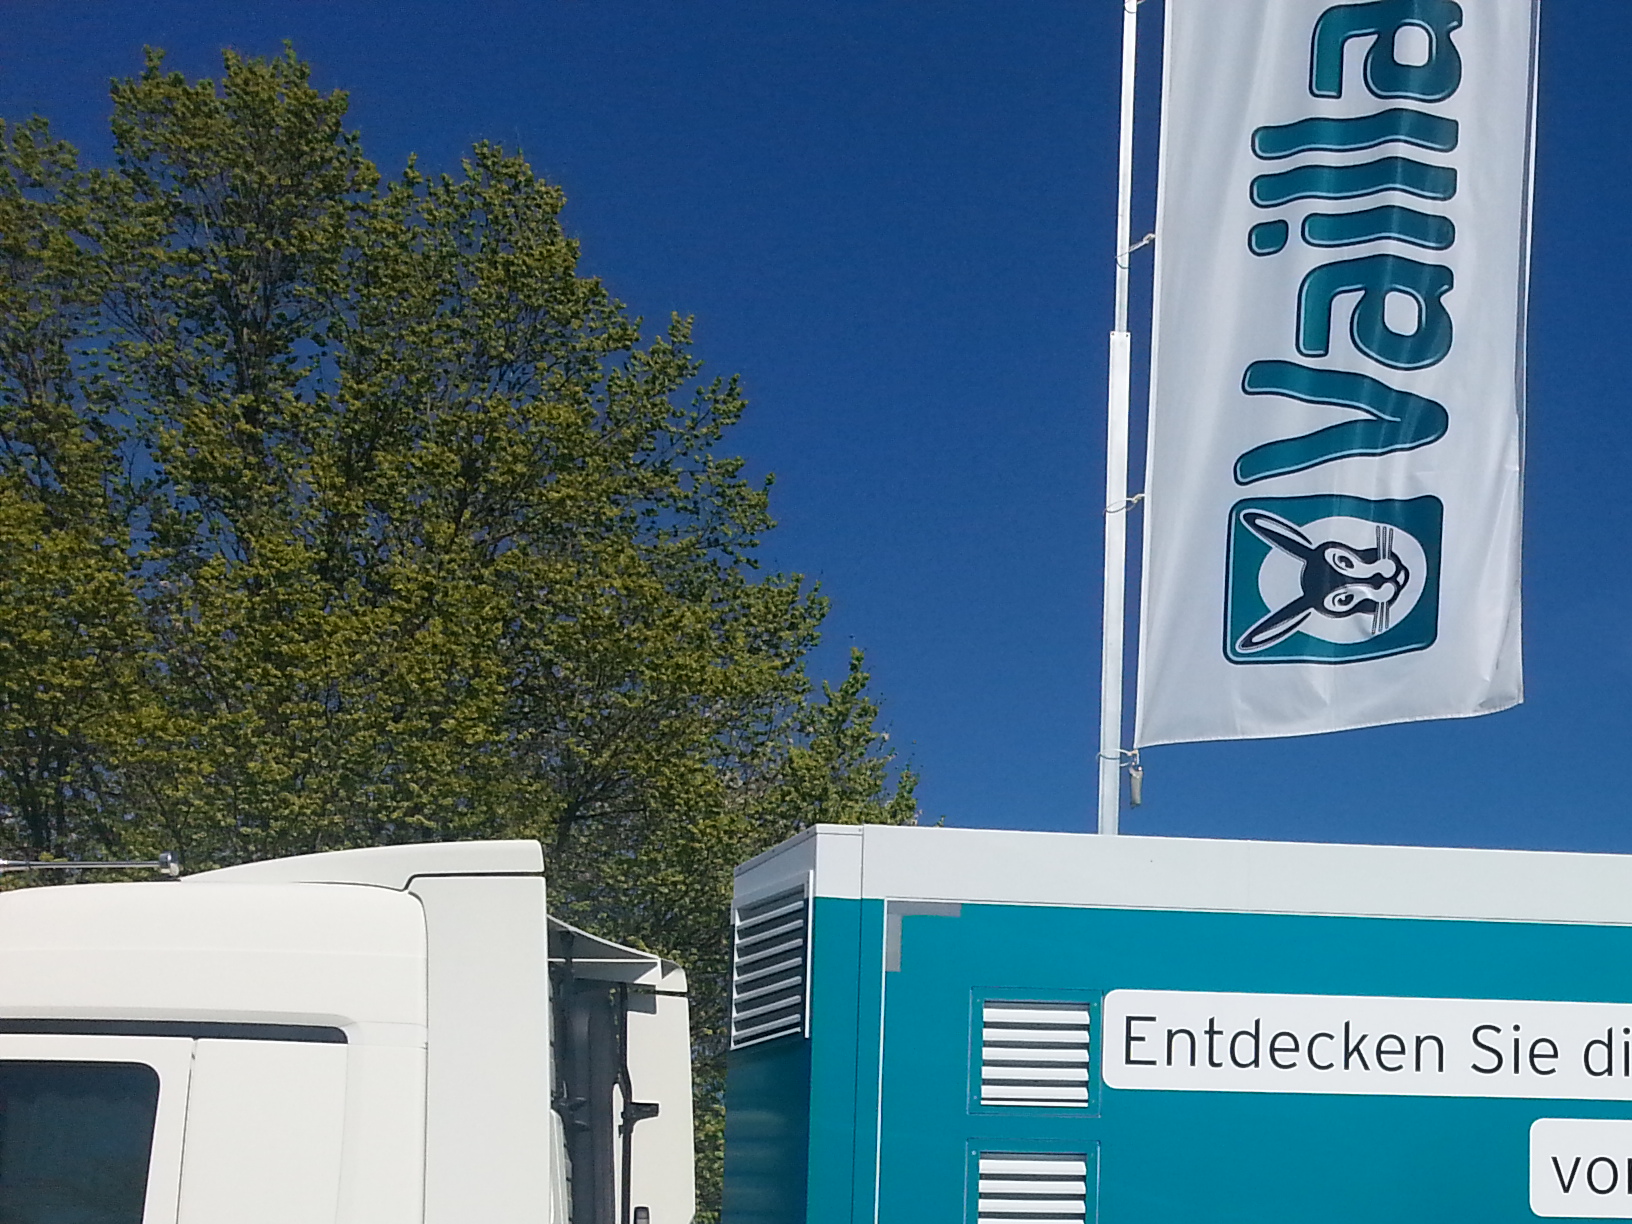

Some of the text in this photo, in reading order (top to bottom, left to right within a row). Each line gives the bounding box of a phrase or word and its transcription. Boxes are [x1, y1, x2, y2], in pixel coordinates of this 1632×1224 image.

[1234, 0, 1464, 486] Vailla
[1124, 1015, 1445, 1074] Entdecken
[1471, 1024, 1559, 1078] Sie
